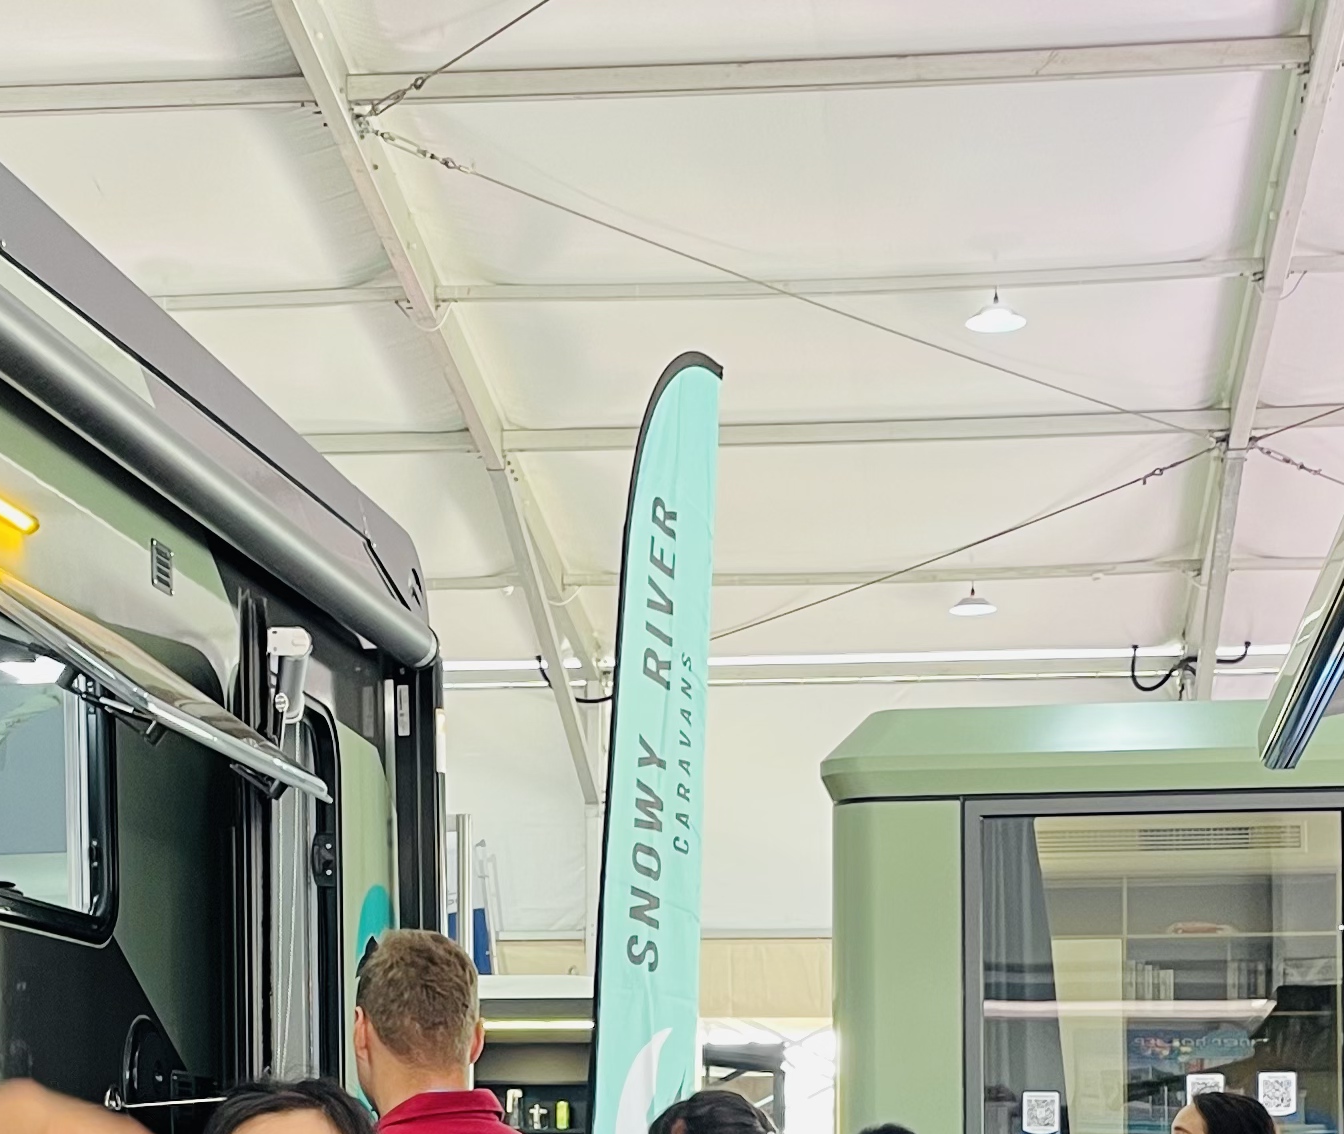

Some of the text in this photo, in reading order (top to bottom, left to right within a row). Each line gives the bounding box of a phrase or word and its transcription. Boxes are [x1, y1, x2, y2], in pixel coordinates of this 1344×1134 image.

[626, 496, 678, 973] SNOWY RIVER
[672, 651, 693, 856] CARAVANS
